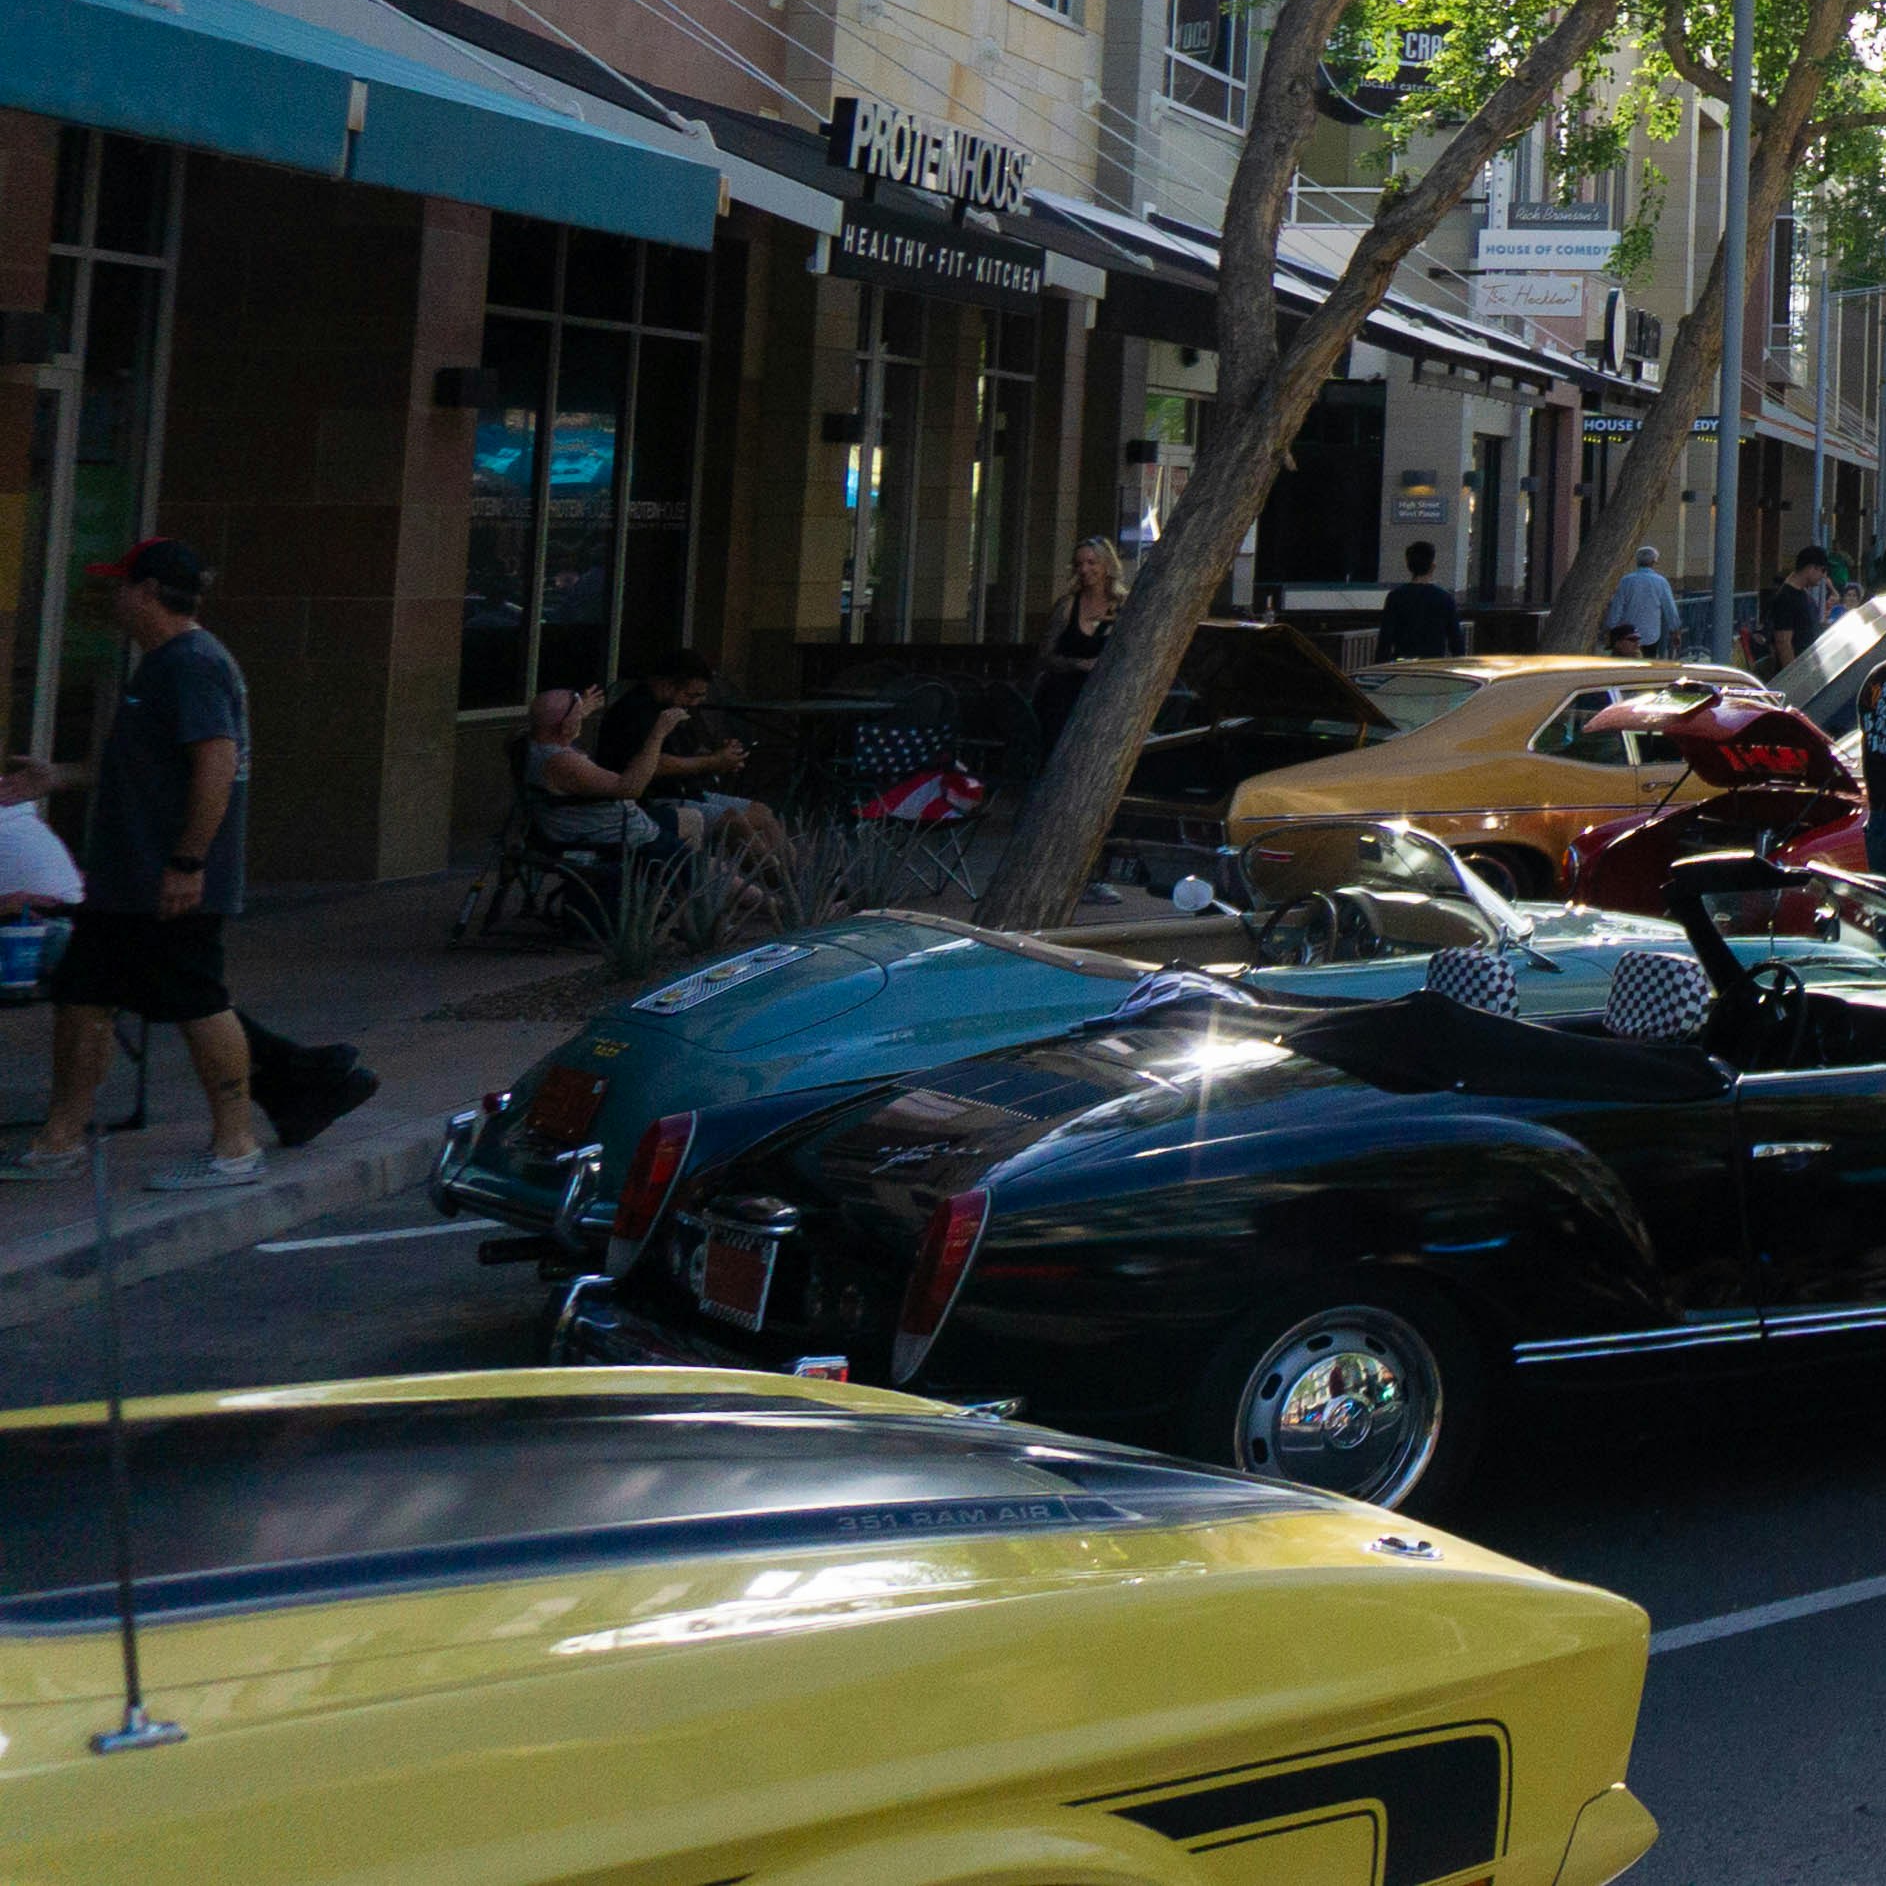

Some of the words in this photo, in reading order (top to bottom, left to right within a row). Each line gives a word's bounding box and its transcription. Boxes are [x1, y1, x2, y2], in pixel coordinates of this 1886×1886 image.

[849, 98, 1035, 217] PROTEINHOUSE
[843, 223, 926, 268] HEALTHY
[937, 248, 965, 278] FIT
[976, 265, 1041, 294] KITCHEN
[1486, 245, 1531, 256] HOUSE
[1535, 245, 1551, 256] OF
[1556, 245, 1609, 256] COMEDY
[1584, 420, 1632, 431] HOUSE
[838, 1514, 898, 1532] 351
[911, 1509, 987, 1527] RAM
[999, 1505, 1051, 1521] AIR
